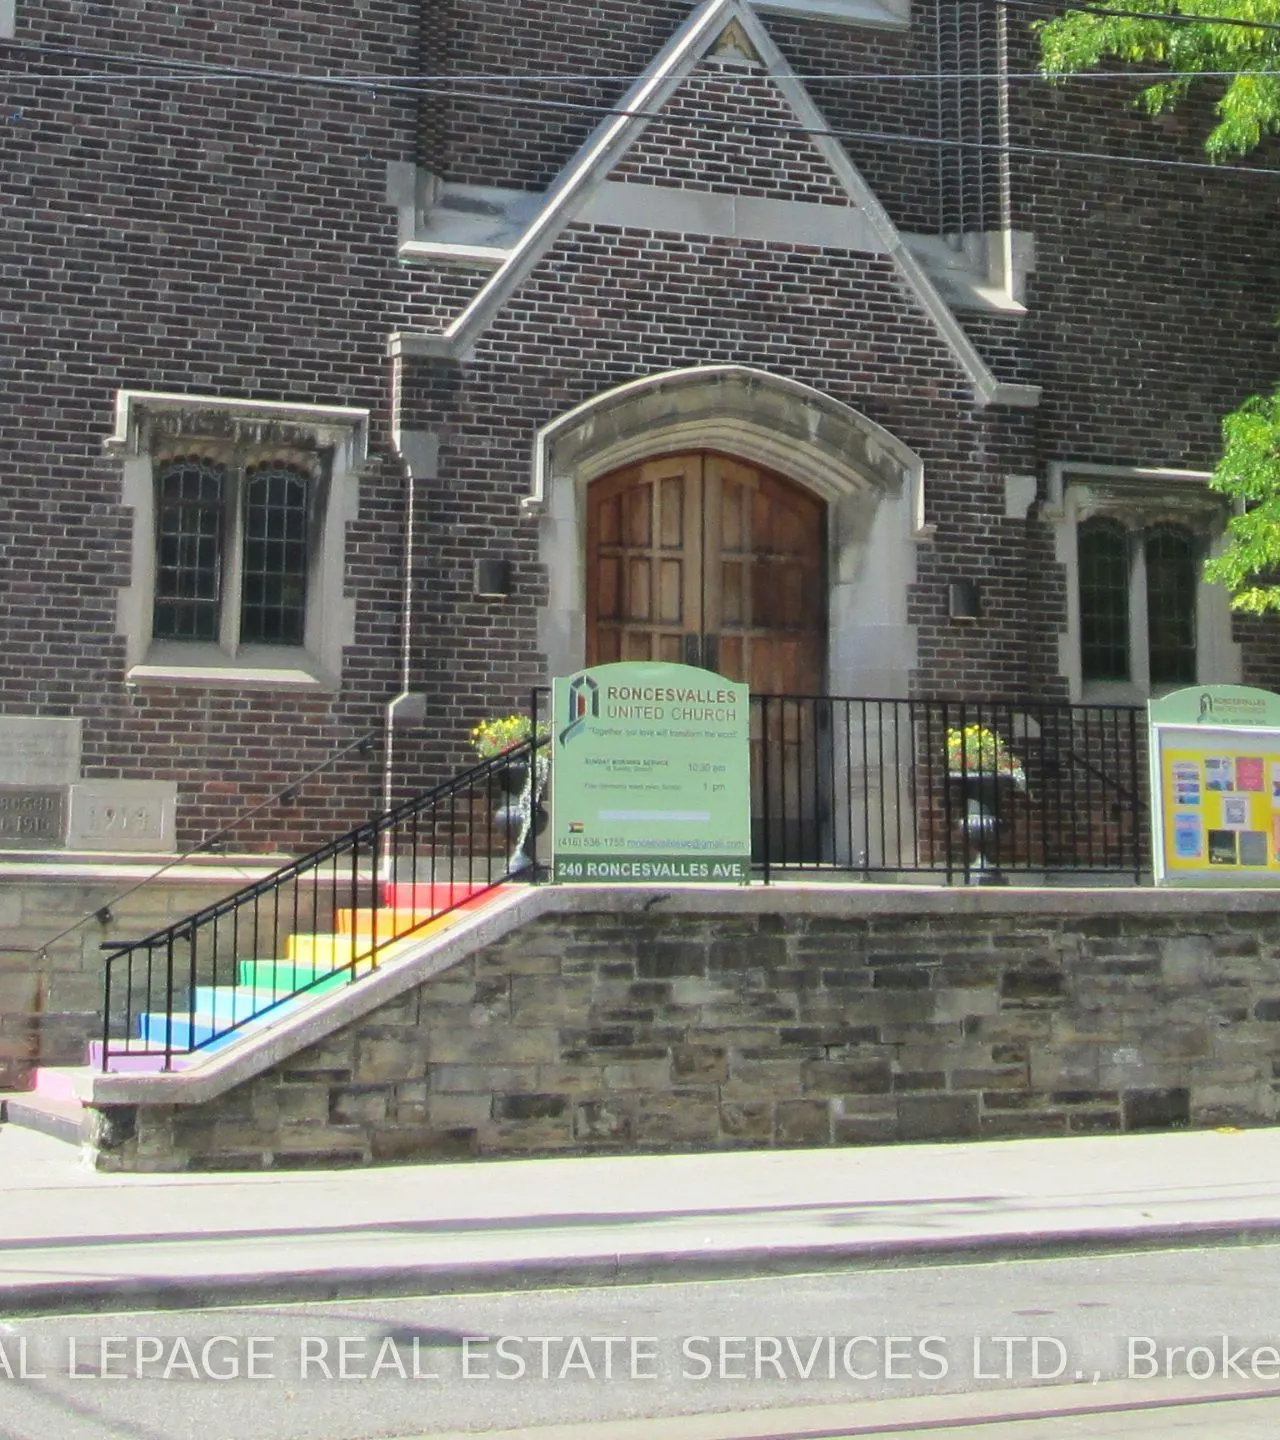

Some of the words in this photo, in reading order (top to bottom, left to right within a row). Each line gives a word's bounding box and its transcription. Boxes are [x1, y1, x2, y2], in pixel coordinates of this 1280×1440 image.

[607, 686, 737, 704] RONCESVALLES
[607, 705, 664, 720] UNITED
[671, 707, 736, 722] CHURCH
[558, 862, 583, 876] 240
[587, 862, 709, 877] RONCESVALLES
[712, 863, 745, 878] AVE.
